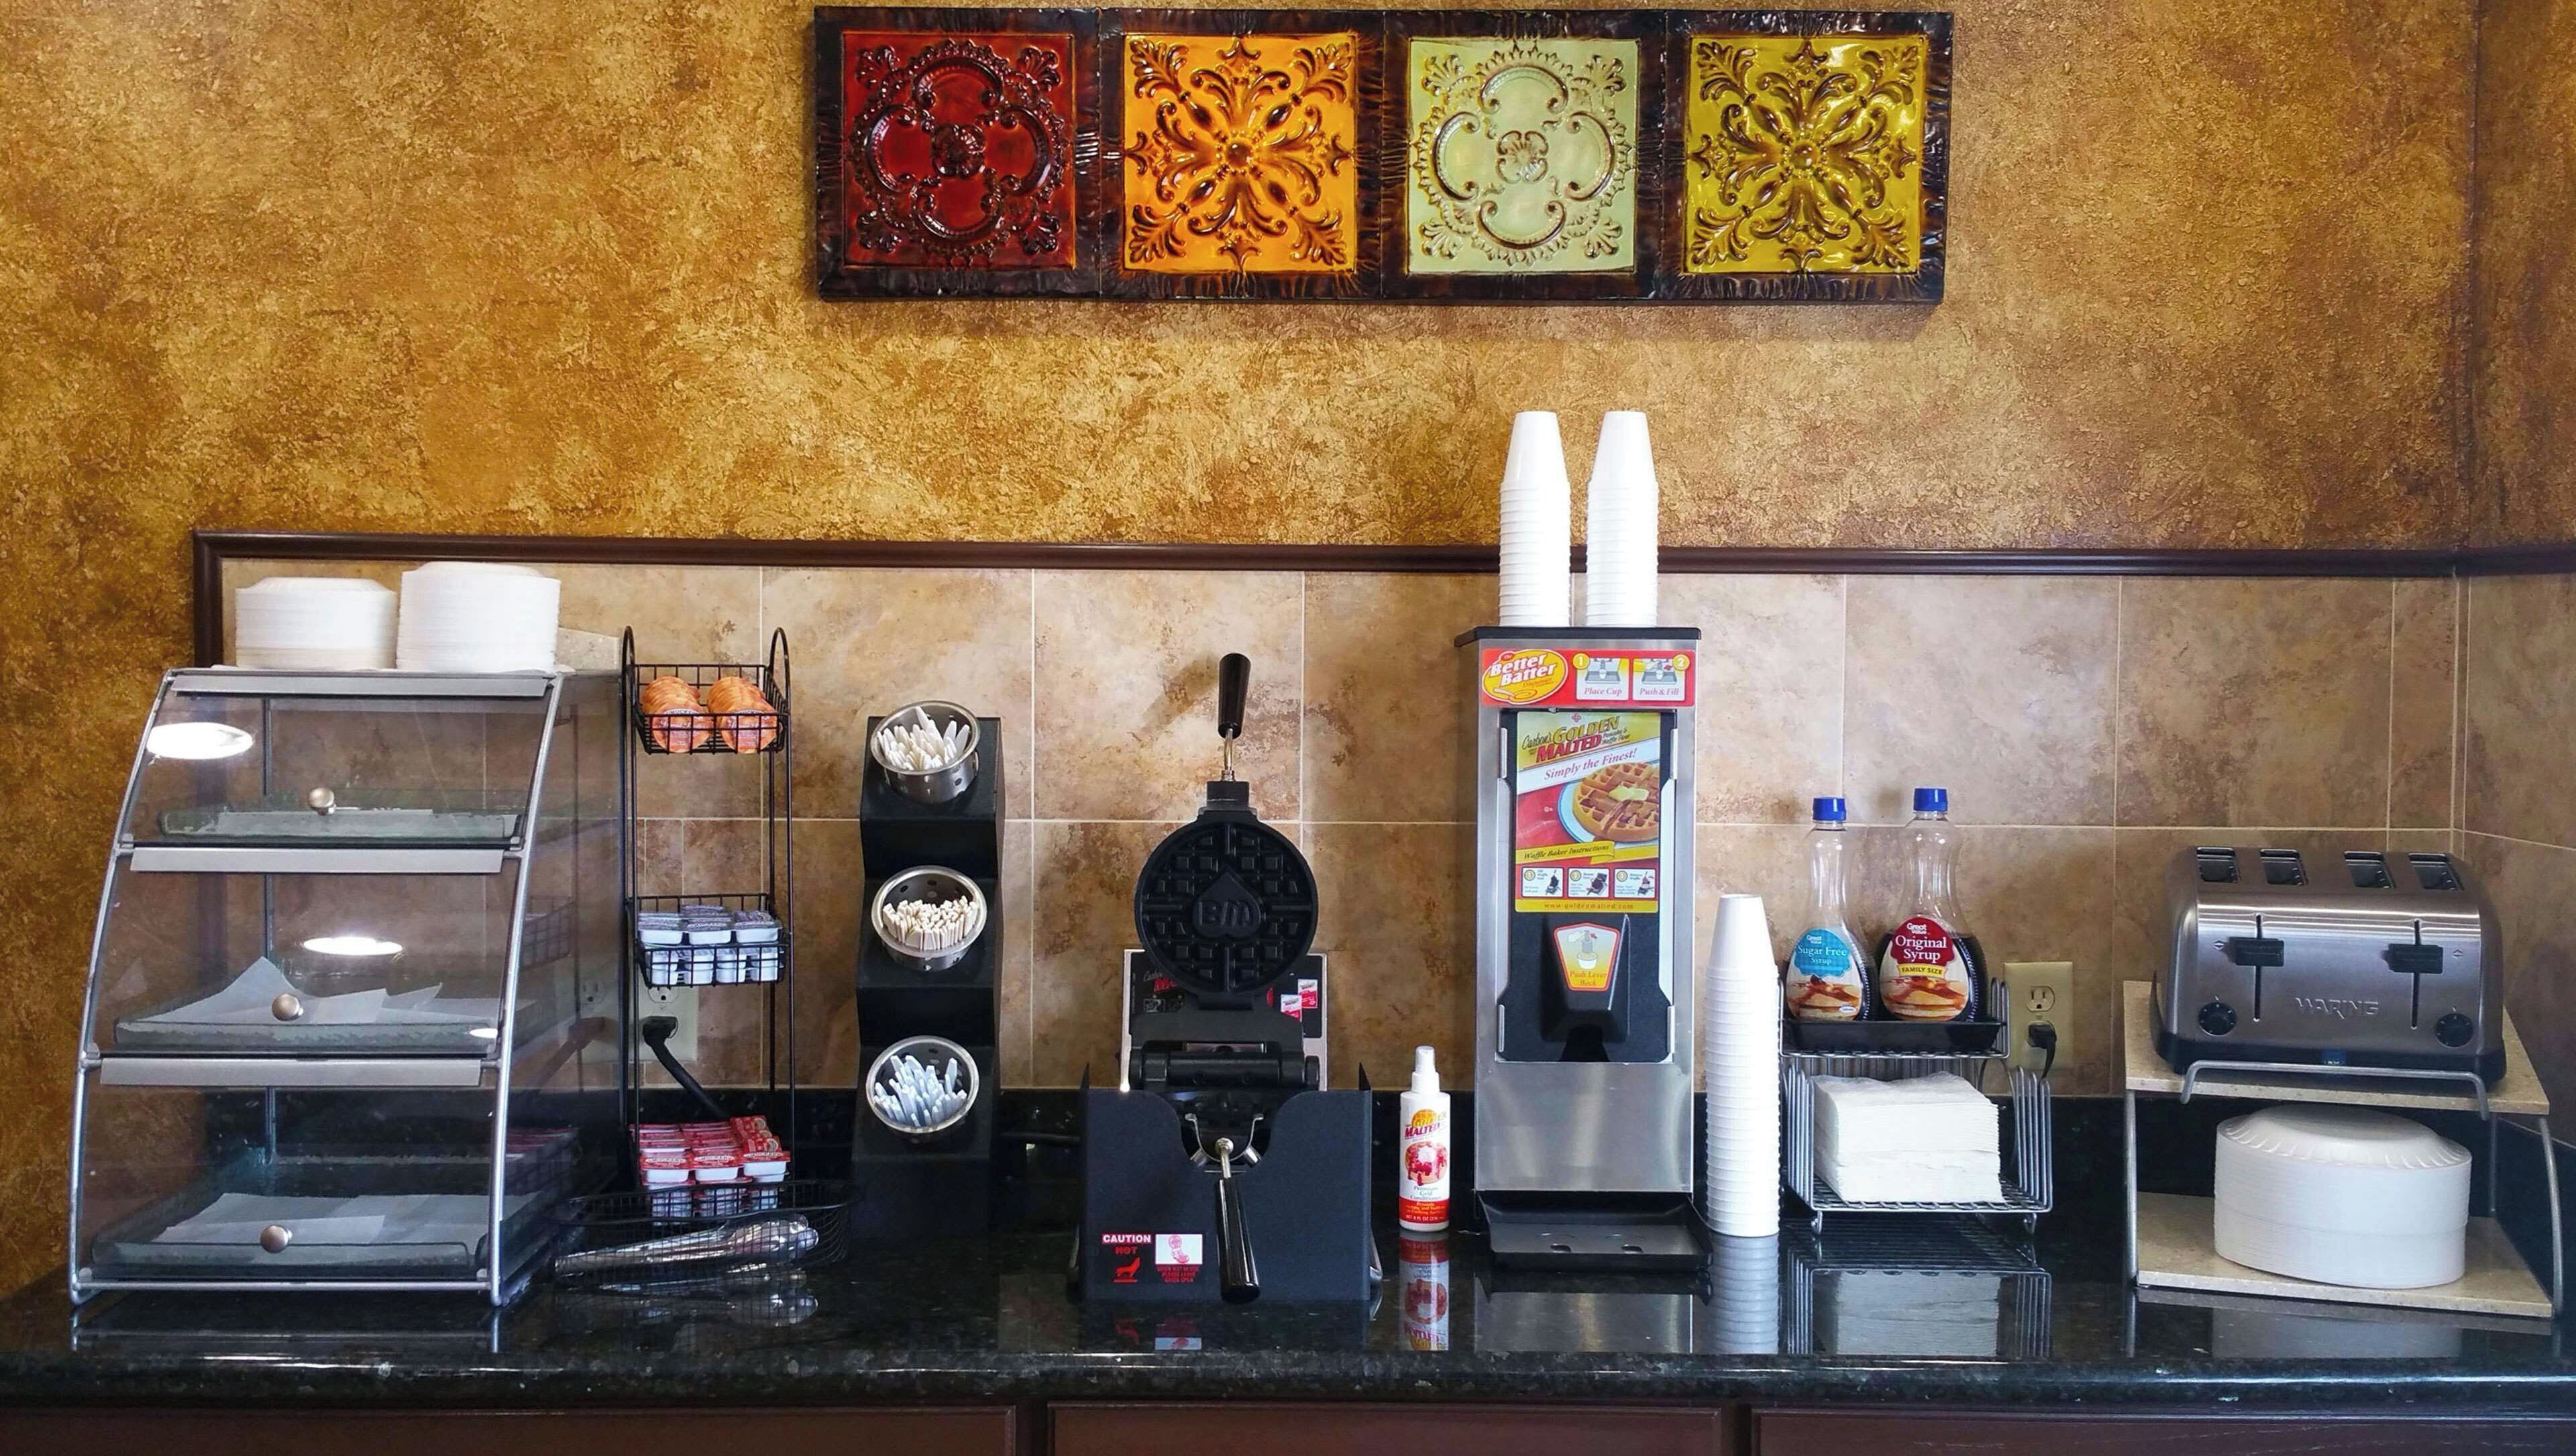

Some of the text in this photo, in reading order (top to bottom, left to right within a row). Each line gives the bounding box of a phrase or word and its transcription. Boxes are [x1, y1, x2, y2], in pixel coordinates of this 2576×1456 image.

[1489, 653, 1548, 677] Better
[1578, 658, 1584, 666] 1
[1678, 658, 1684, 666] 2
[1501, 663, 1557, 686] Batter
[1607, 688, 1622, 696] Cup
[1553, 715, 1620, 744] GOLDEN
[1536, 734, 1603, 762] MALTED
[1544, 748, 1638, 780] Simply the Finest!
[1523, 851, 1546, 860] Waffle
[1569, 845, 1610, 855] Instructions
[1907, 923, 1927, 931] Great
[1895, 935, 1947, 951] Original
[1797, 945, 1847, 957] Sugar Free
[1903, 949, 1941, 964] Syrup
[1102, 1234, 1151, 1243] CAUTION
